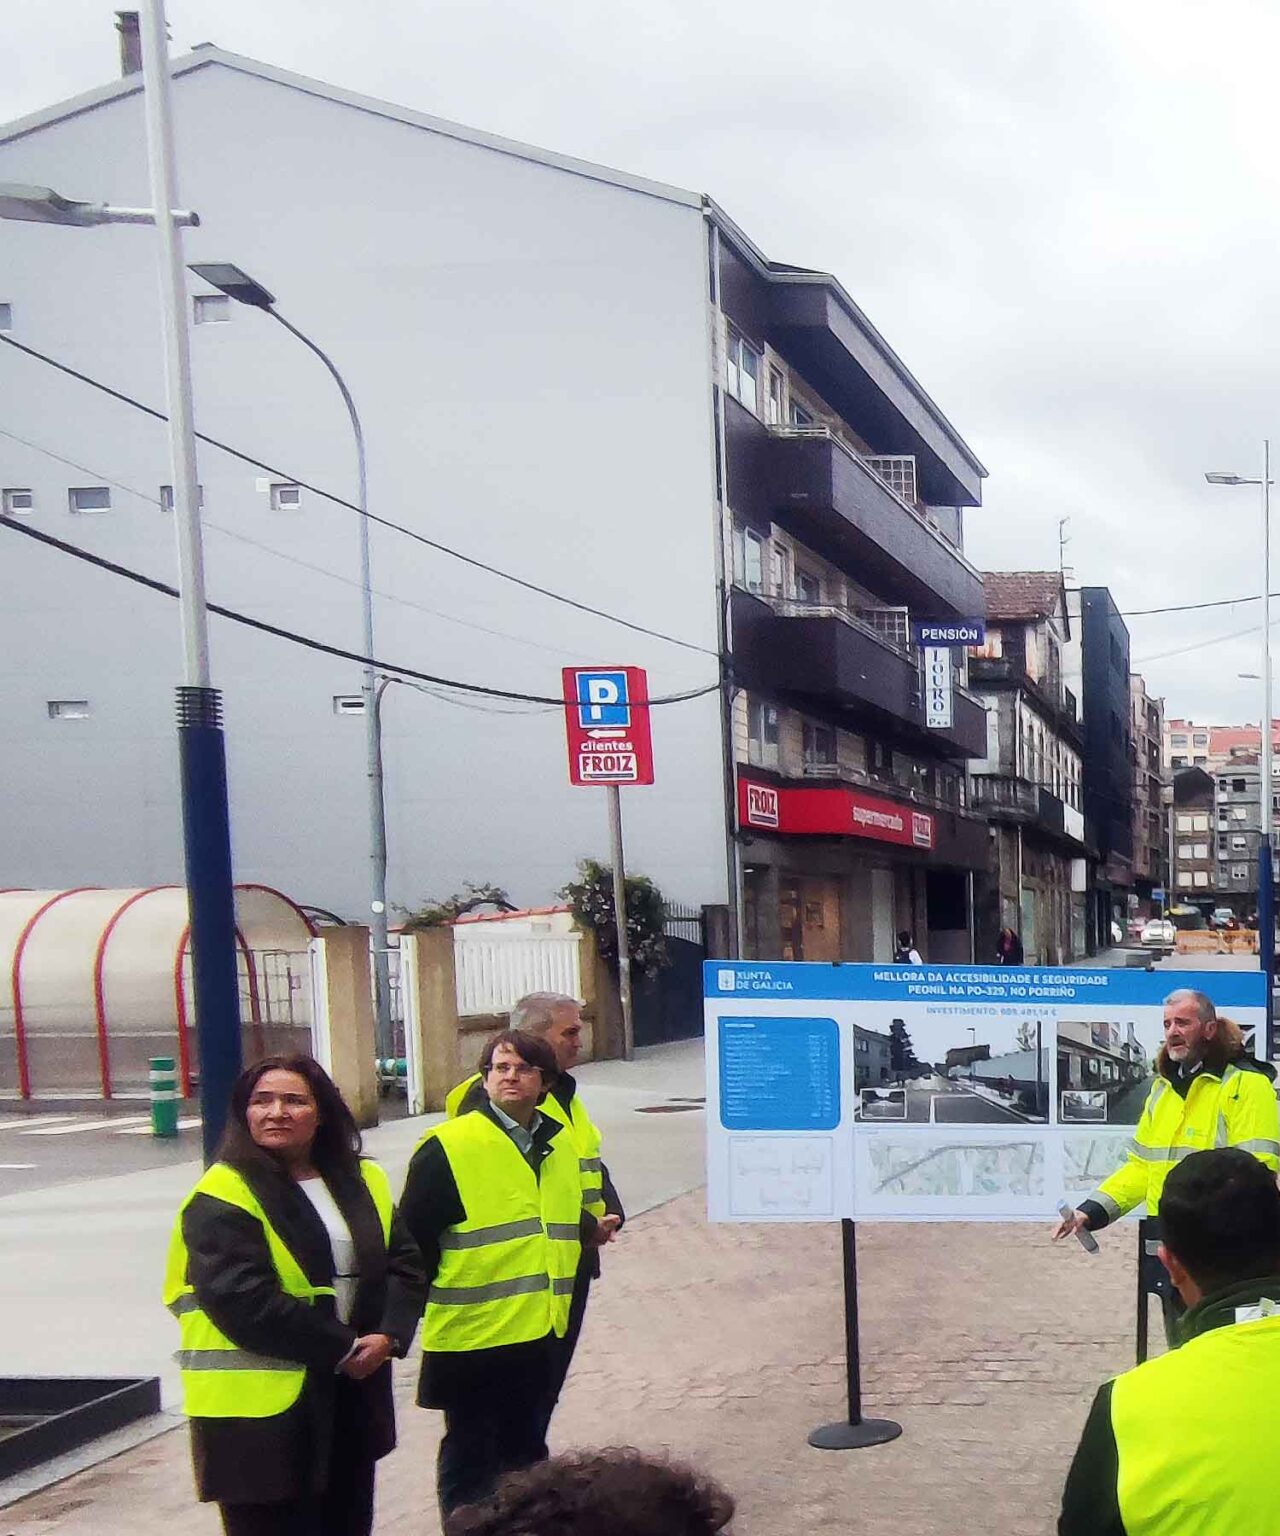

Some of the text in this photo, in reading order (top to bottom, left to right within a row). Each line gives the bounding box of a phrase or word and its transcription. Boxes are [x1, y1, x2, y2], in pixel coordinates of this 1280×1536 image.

[922, 627, 978, 640] PENSIÓN
[932, 649, 945, 712] LOURO
[588, 679, 618, 719] P
[580, 740, 633, 752] clientes
[582, 755, 633, 772] FROIZ
[750, 788, 776, 816] FROIZ
[853, 806, 903, 832] supermercado
[914, 813, 931, 837] FROIZ
[736, 971, 772, 981] XUNTA
[874, 971, 1108, 986] MELLORA DA ACCESIBILIDADE E SEGURIDADE
[736, 980, 793, 990] DE GALICIA
[908, 985, 947, 995] PEONIL
[949, 985, 965, 995] NA
[1010, 987, 1026, 997] NO
[1029, 985, 1076, 998] PORRIÑO
